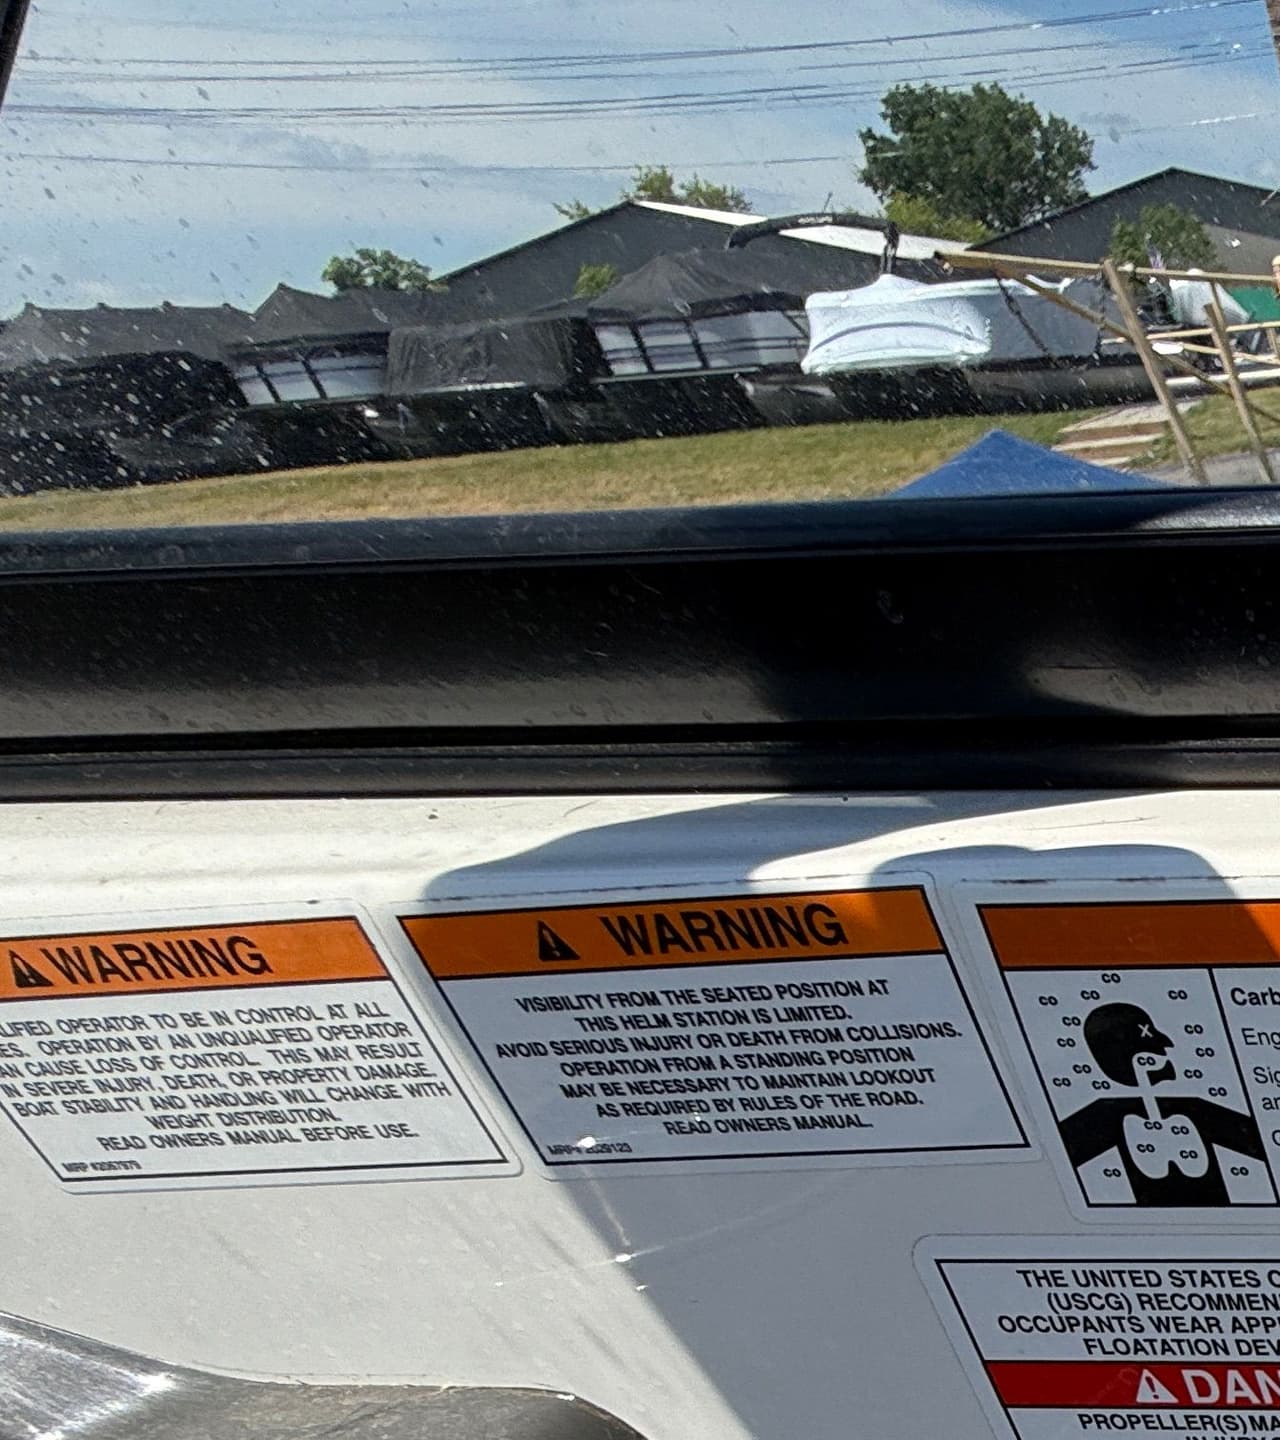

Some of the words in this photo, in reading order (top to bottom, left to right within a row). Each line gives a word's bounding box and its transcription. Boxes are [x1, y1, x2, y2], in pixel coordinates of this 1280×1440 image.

[597, 903, 849, 956] WARNING
[40, 936, 274, 984] WARNING
[514, 994, 604, 1013] VISIBILITY
[606, 991, 662, 1008] FROM
[659, 989, 701, 1005] THE
[701, 985, 773, 1003] SEATED
[774, 980, 865, 1000] POSITION
[868, 979, 889, 995] AT
[11, 1101, 59, 1117] BOAT
[61, 1097, 144, 1114] STABILITY
[149, 1095, 186, 1110] AND
[187, 1090, 279, 1108] HANDLING
[278, 1088, 326, 1104] WILL
[326, 1084, 403, 1102] CHANGE
[402, 1081, 452, 1098] WITH
[144, 1113, 214, 1130] WEIGHT
[215, 1108, 342, 1127] DISTRIBUTION.
[662, 1120, 712, 1135] READ
[714, 1117, 792, 1133] OWNERS
[792, 1114, 873, 1130] MANUAL.
[96, 1136, 147, 1151] READ
[149, 1132, 225, 1149] OWNERS
[225, 1129, 302, 1145] MANUAL
[300, 1125, 374, 1142] BEFORE
[373, 1123, 419, 1139] USE.
[1016, 1270, 1069, 1288] THE
[1071, 1270, 1162, 1288] UNITED
[1168, 1269, 1261, 1288] STATES
[1047, 1292, 1132, 1315] (USCG)
